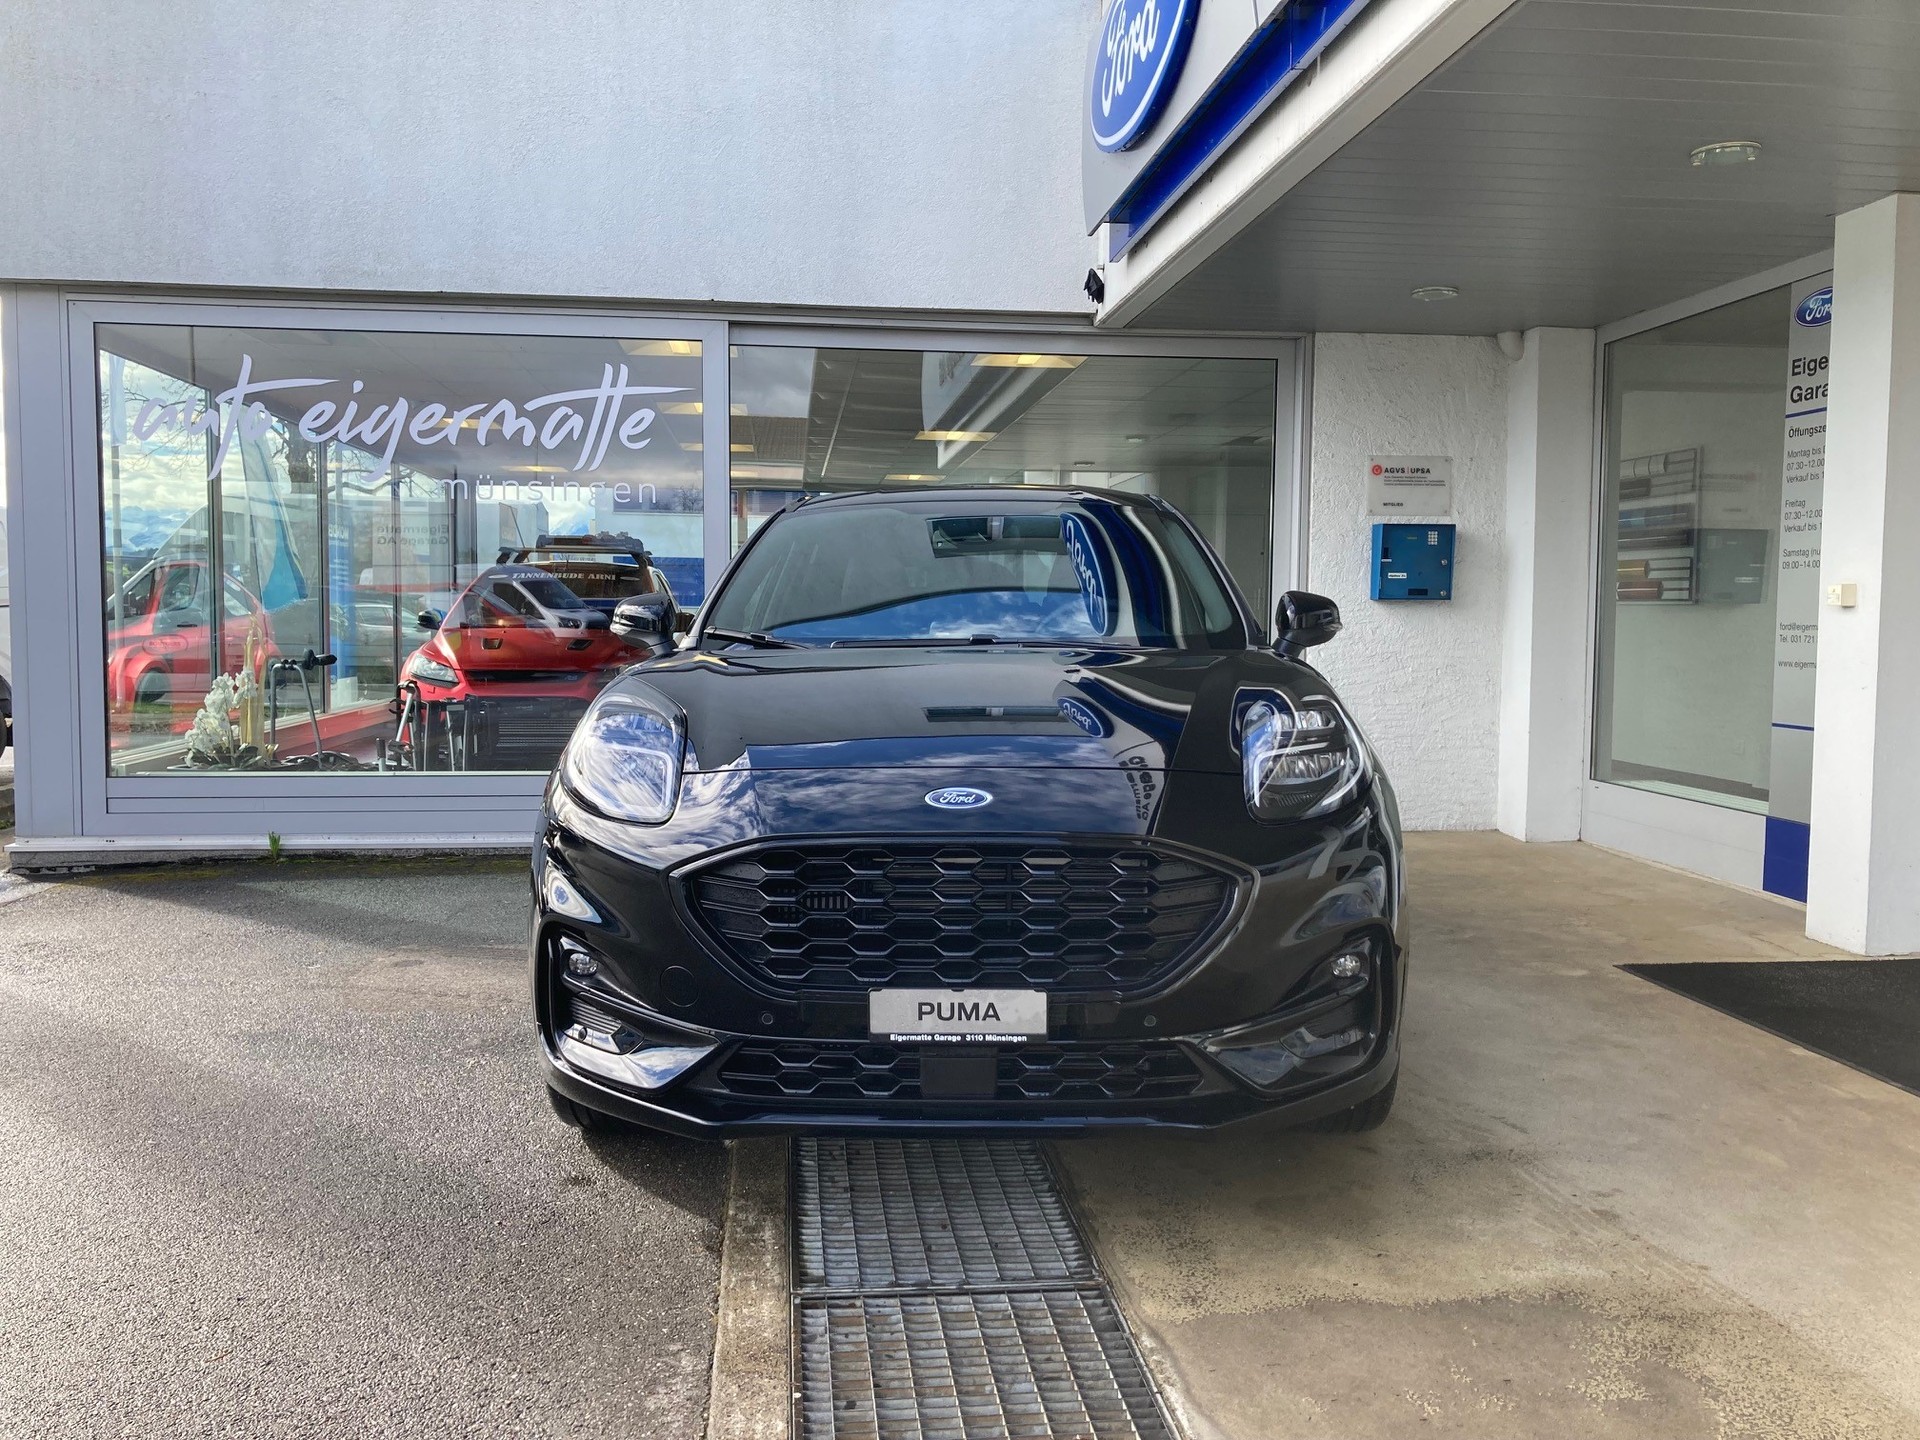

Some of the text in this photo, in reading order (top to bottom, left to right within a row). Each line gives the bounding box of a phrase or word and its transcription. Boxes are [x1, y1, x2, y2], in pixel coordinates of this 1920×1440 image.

[1805, 293, 1832, 321] For
[1791, 356, 1829, 376] Eige
[1790, 383, 1829, 403] Gara
[132, 354, 696, 482] auto eigermatte
[1787, 449, 1810, 458] Montag
[1812, 447, 1821, 455] bis
[1786, 473, 1809, 483] Verkauf
[436, 474, 657, 508] münsingen
[1785, 500, 1806, 508] Freitag
[1783, 523, 1807, 533] Verkauf
[1807, 523, 1818, 531] bis
[1782, 548, 1810, 558] Samstag
[512, 572, 616, 581] TANNENBUDE ARNI
[1790, 634, 1802, 643] 031
[1803, 634, 1815, 644] 721
[939, 791, 976, 804] Ford
[917, 1002, 1001, 1021] PUMA
[890, 1034, 932, 1042] Eigermatte
[934, 1034, 961, 1042] Garage
[986, 1033, 1027, 1042] Münsingen
